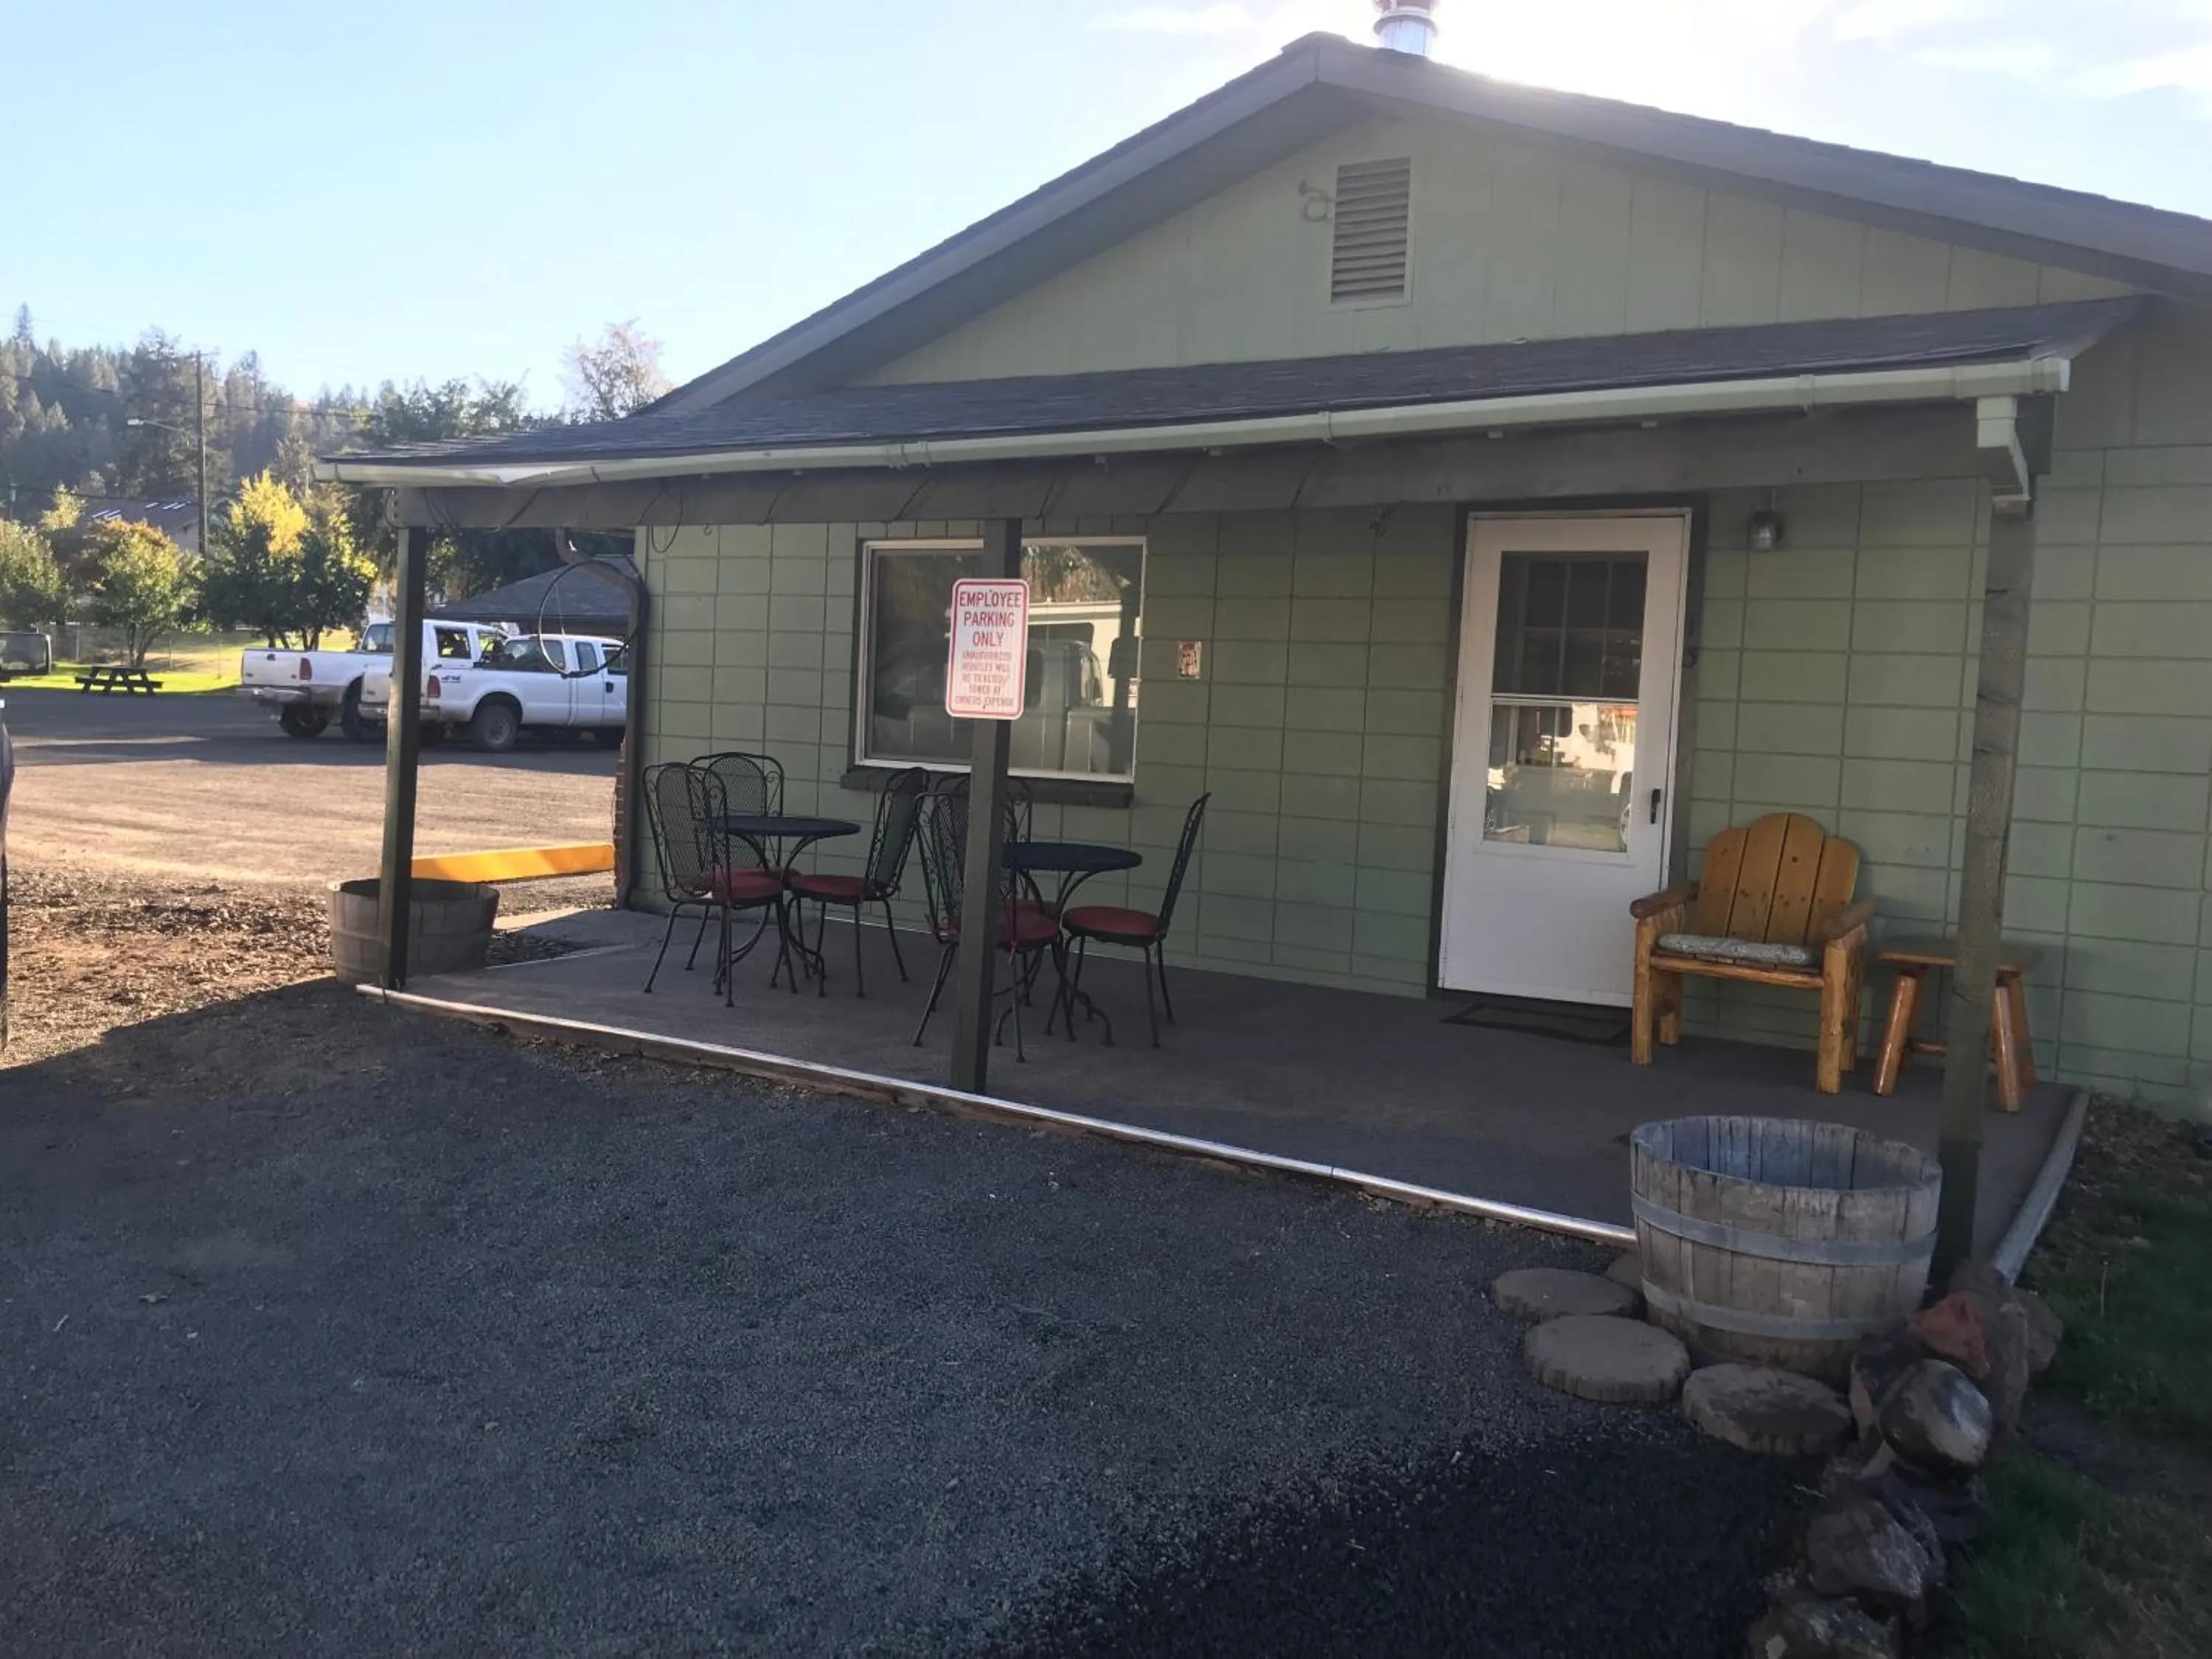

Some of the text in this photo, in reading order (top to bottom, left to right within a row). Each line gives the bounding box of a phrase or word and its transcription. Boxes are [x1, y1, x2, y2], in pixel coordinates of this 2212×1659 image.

[959, 591, 1022, 608] EMPLOYEE
[964, 611, 1015, 627] PARKING
[973, 630, 1004, 647] ONLY
